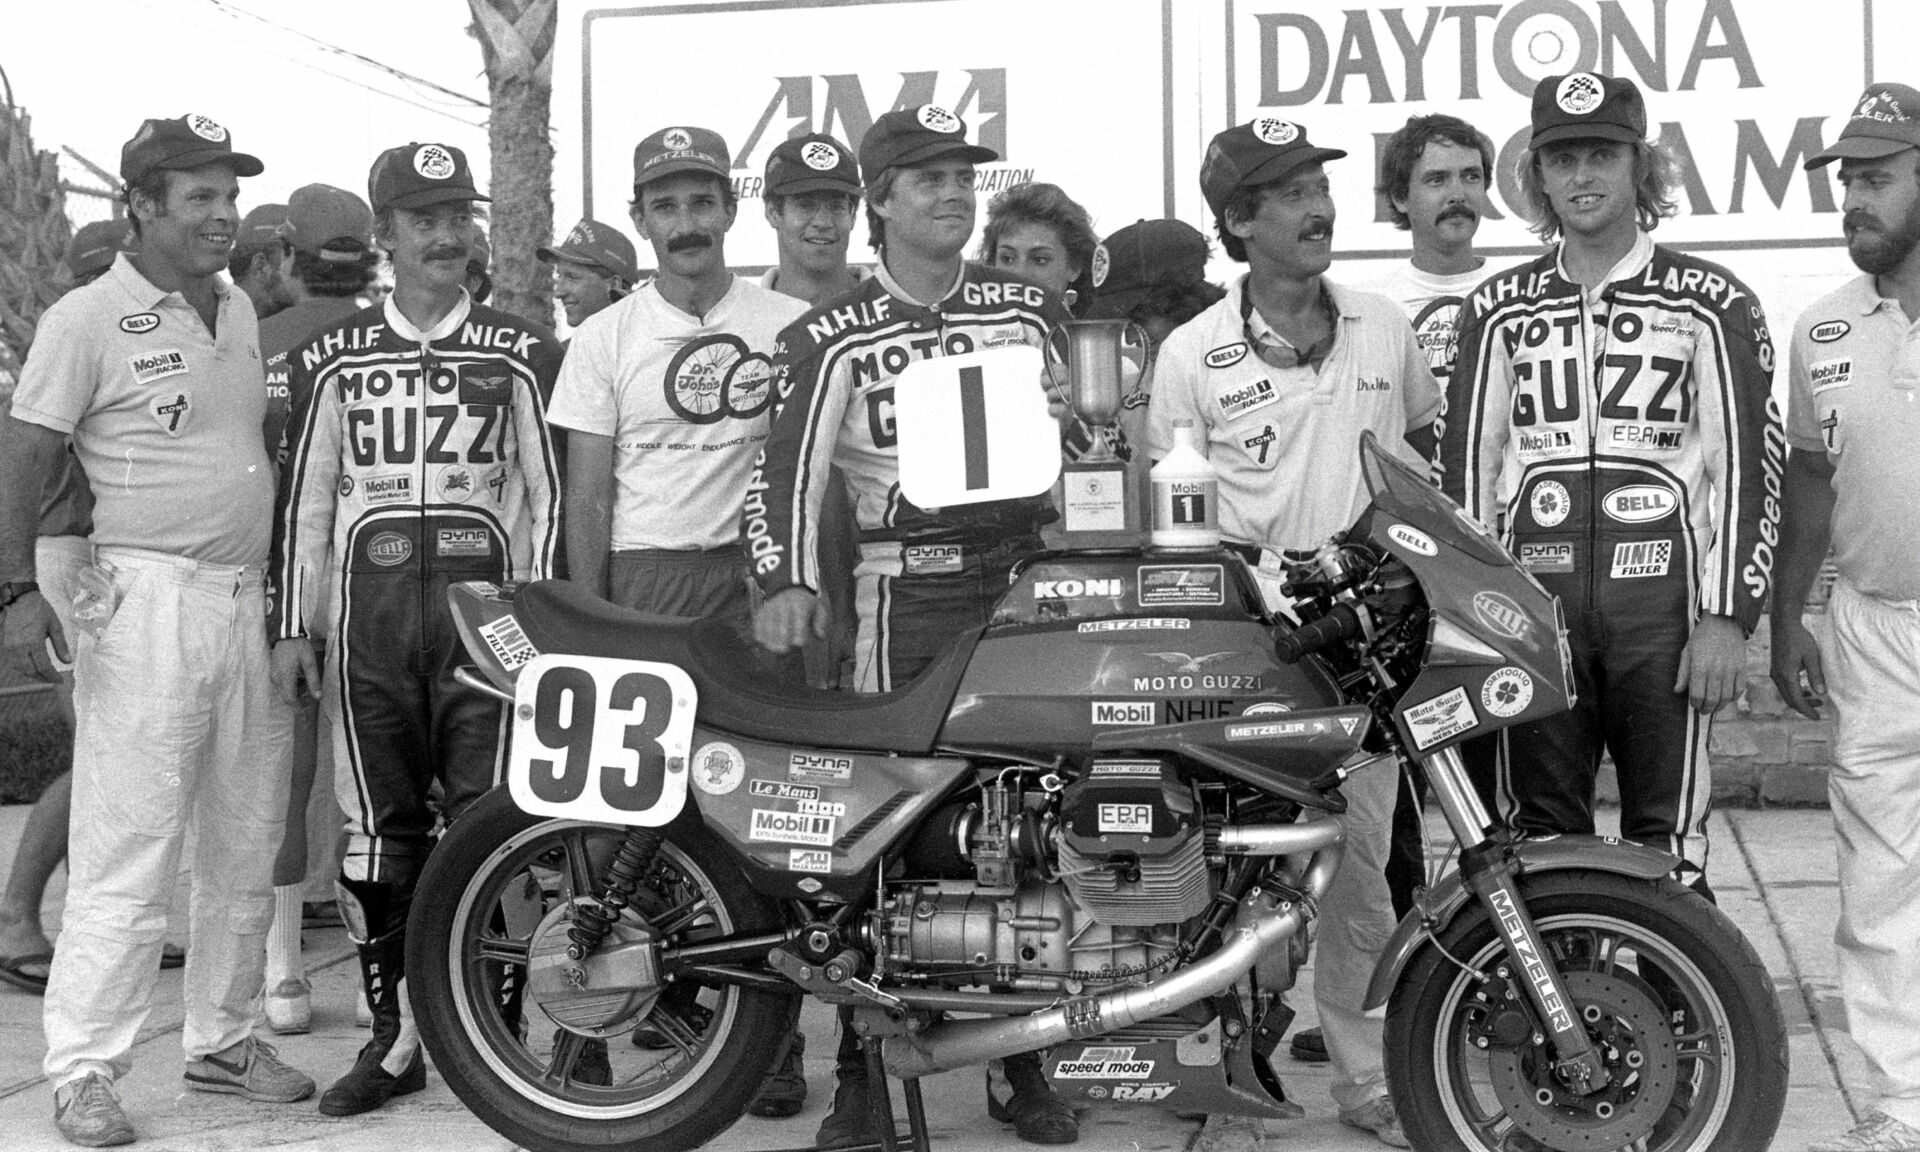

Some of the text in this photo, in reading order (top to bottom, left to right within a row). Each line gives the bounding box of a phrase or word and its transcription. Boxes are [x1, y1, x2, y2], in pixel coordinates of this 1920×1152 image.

[1250, 0, 1766, 107] DAYTONA
[964, 282, 1045, 307] GREG
[1643, 262, 1746, 310] LARRY
[126, 317, 156, 329] BELL
[1817, 325, 1842, 338] BELL
[461, 322, 541, 359] NICK
[133, 354, 169, 373] Mobil
[851, 333, 975, 388] MOTO
[1211, 348, 1244, 364] BELL
[157, 363, 186, 375] RACING
[338, 368, 458, 404] MOTO
[677, 375, 720, 391] John's
[1513, 354, 1694, 427] GUZZI
[1219, 385, 1257, 409] Mobil
[1243, 391, 1275, 408] RACING
[158, 403, 188, 414] KONI
[348, 404, 507, 466] GUZZI
[1247, 433, 1276, 447] KONI
[1519, 434, 1553, 451] Mobil
[701, 436, 747, 452] ENDURANCE
[366, 479, 396, 493] Mobil
[1180, 496, 1194, 522] 1
[1616, 493, 1667, 512] BELL
[440, 531, 487, 541] DYNA
[1397, 530, 1430, 551] BELL
[908, 547, 959, 557] DYNA
[1522, 545, 1571, 556] DYNA
[1621, 564, 1662, 576] FILTER
[1034, 578, 1122, 599] KONI
[1080, 619, 1190, 632] METZELER
[486, 633, 513, 665] FILTER
[1134, 675, 1262, 691] MOTO GUZZI
[1484, 668, 1530, 706] QUADRIFOGLIO
[1097, 700, 1234, 724] Mobil NHIF
[1231, 723, 1305, 737] METZELER
[528, 666, 673, 812] 93
[792, 754, 851, 769] DYNA
[754, 782, 817, 799] Le Mans
[797, 800, 846, 817] 1000
[755, 812, 809, 833] Mobil
[1491, 890, 1572, 1031] METZELER
[369, 963, 383, 1005] RAY
[501, 963, 514, 1005] RAY
[1059, 1061, 1150, 1075] speed mode
[1111, 1086, 1177, 1100] RAY
